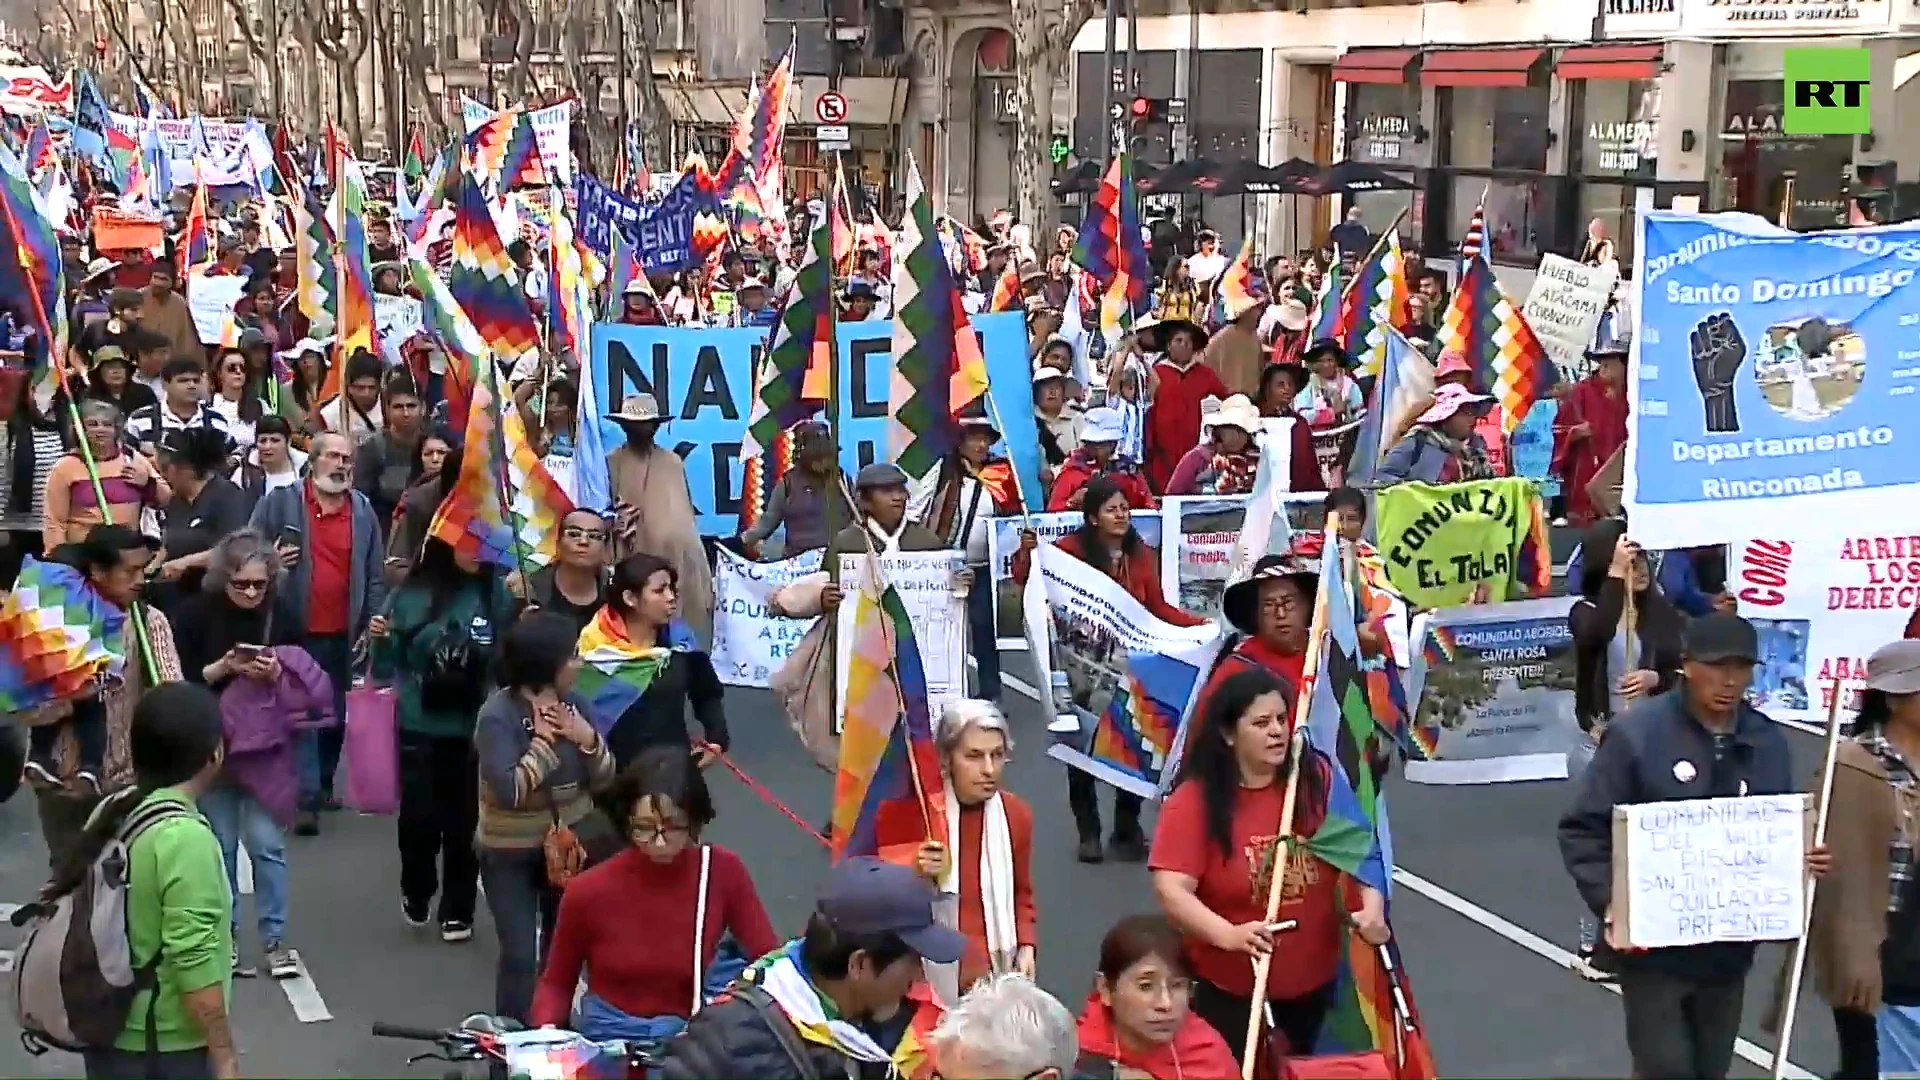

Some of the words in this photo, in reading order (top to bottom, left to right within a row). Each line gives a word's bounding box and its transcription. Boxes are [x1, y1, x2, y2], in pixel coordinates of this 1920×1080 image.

[1362, 116, 1410, 133] ALAMEDA
[1589, 121, 1652, 140] ALAMEDA
[581, 207, 694, 252] PRSENT
[1667, 278, 1741, 304] Santo
[1752, 267, 1916, 304] Domingo
[1672, 425, 1894, 465] Departamento
[1702, 467, 1865, 499] Rinconada
[1456, 628, 1522, 645] COMUNIDAD
[1480, 647, 1515, 662] SANTA
[1518, 645, 1547, 661] ROSA
[1640, 801, 1777, 831] COMUNIDAD
